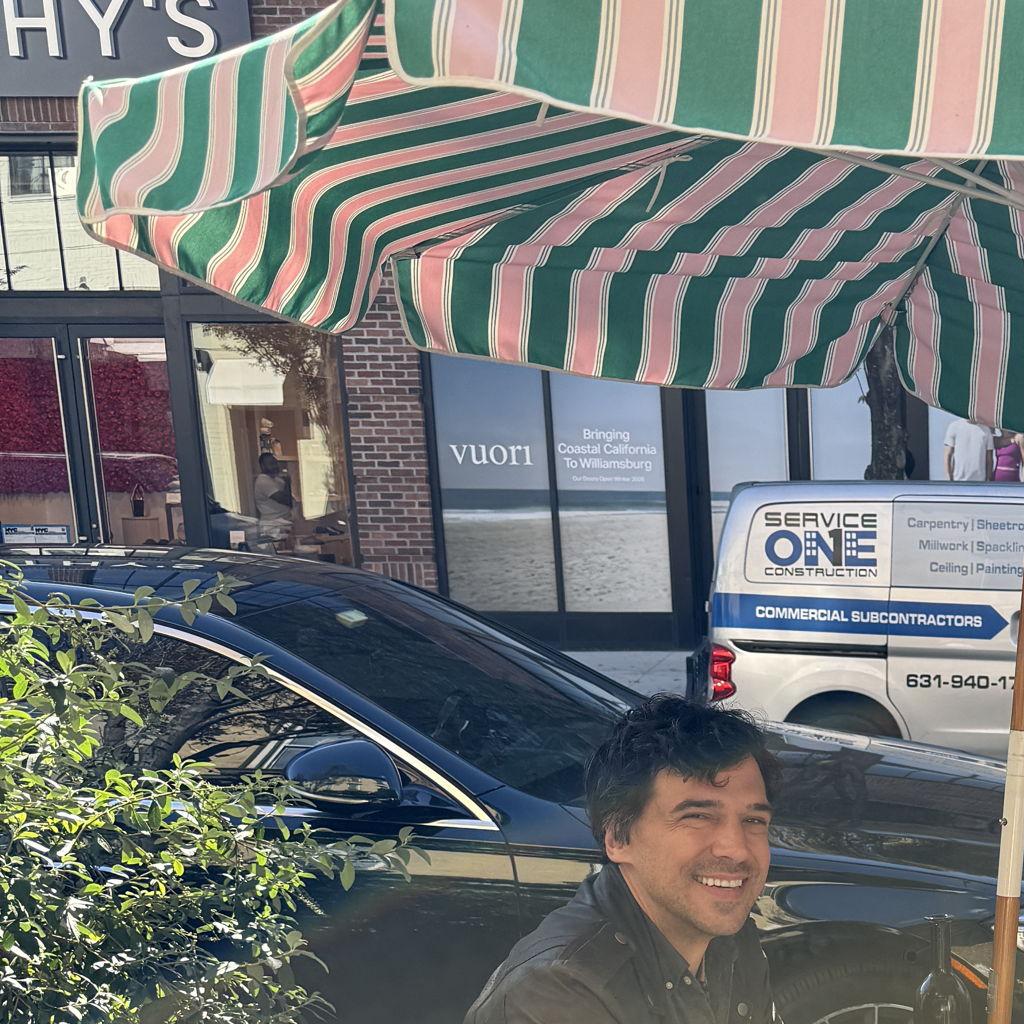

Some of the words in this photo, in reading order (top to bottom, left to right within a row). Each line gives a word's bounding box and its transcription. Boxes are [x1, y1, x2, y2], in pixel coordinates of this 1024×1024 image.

[583, 428, 630, 442] Bringing
[449, 444, 534, 466] vuori
[558, 442, 601, 454] Coastal
[603, 443, 657, 455] California
[563, 457, 578, 468] To
[579, 457, 652, 472] Williamsburg
[765, 512, 877, 528] SERVICE
[907, 518, 969, 532] Carpentry
[765, 529, 877, 566] ONE
[918, 540, 969, 552] Millwork
[765, 567, 877, 578] CONSTRUCTION
[929, 562, 969, 576] Ceiling
[976, 563, 1024, 577] Painting
[755, 606, 848, 622] COMMERCIAL
[851, 610, 983, 628] SUBCONTRACTORS
